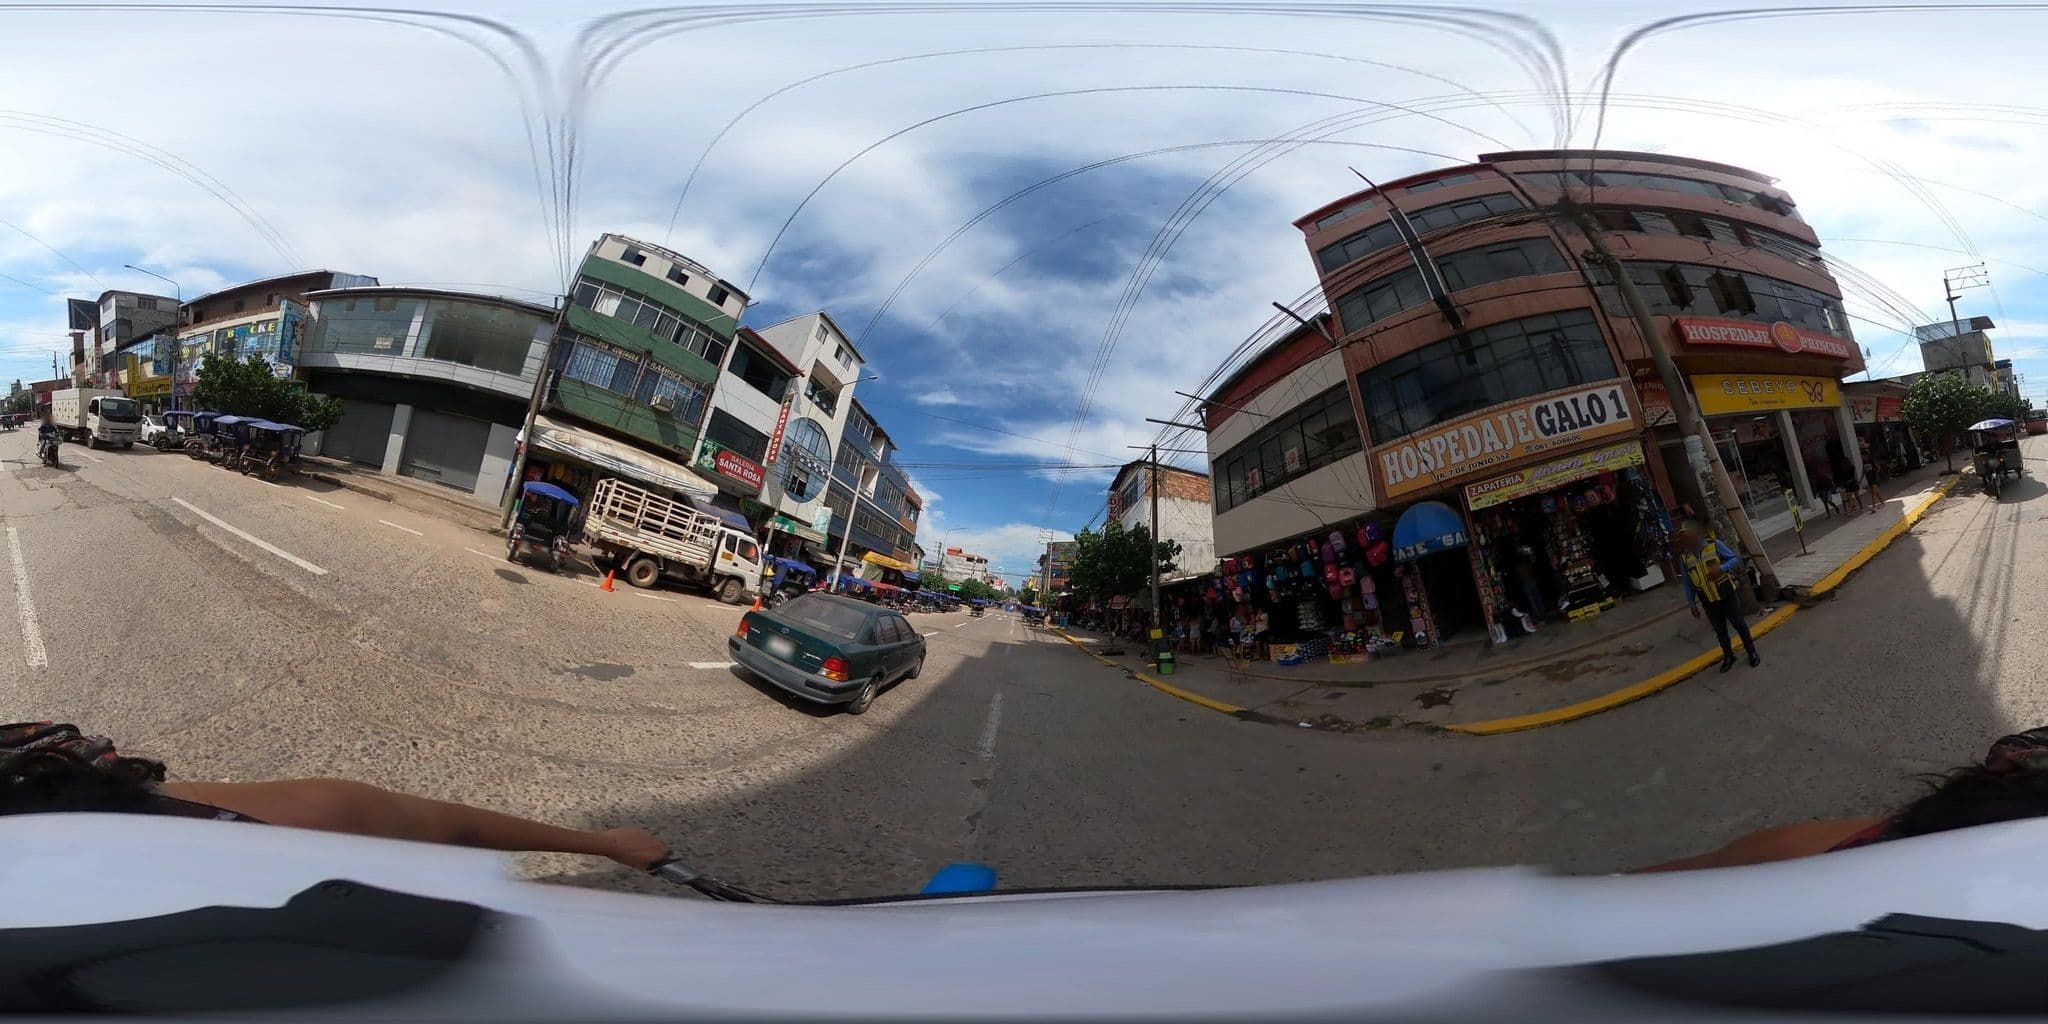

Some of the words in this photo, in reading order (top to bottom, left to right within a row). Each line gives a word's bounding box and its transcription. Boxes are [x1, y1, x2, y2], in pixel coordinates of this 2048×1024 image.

[1684, 325, 1772, 344] HOSPEDAJE
[1801, 337, 1849, 357] PRINCESA
[775, 407, 788, 435] SANTA
[770, 437, 780, 461] ROSA
[1383, 409, 1535, 485] HOSPEDAJE
[1534, 393, 1607, 437] GALO
[1609, 389, 1628, 420] 1
[718, 457, 742, 476] SANTA
[742, 468, 761, 484] ROSA
[1467, 457, 1494, 472] JUNIO
